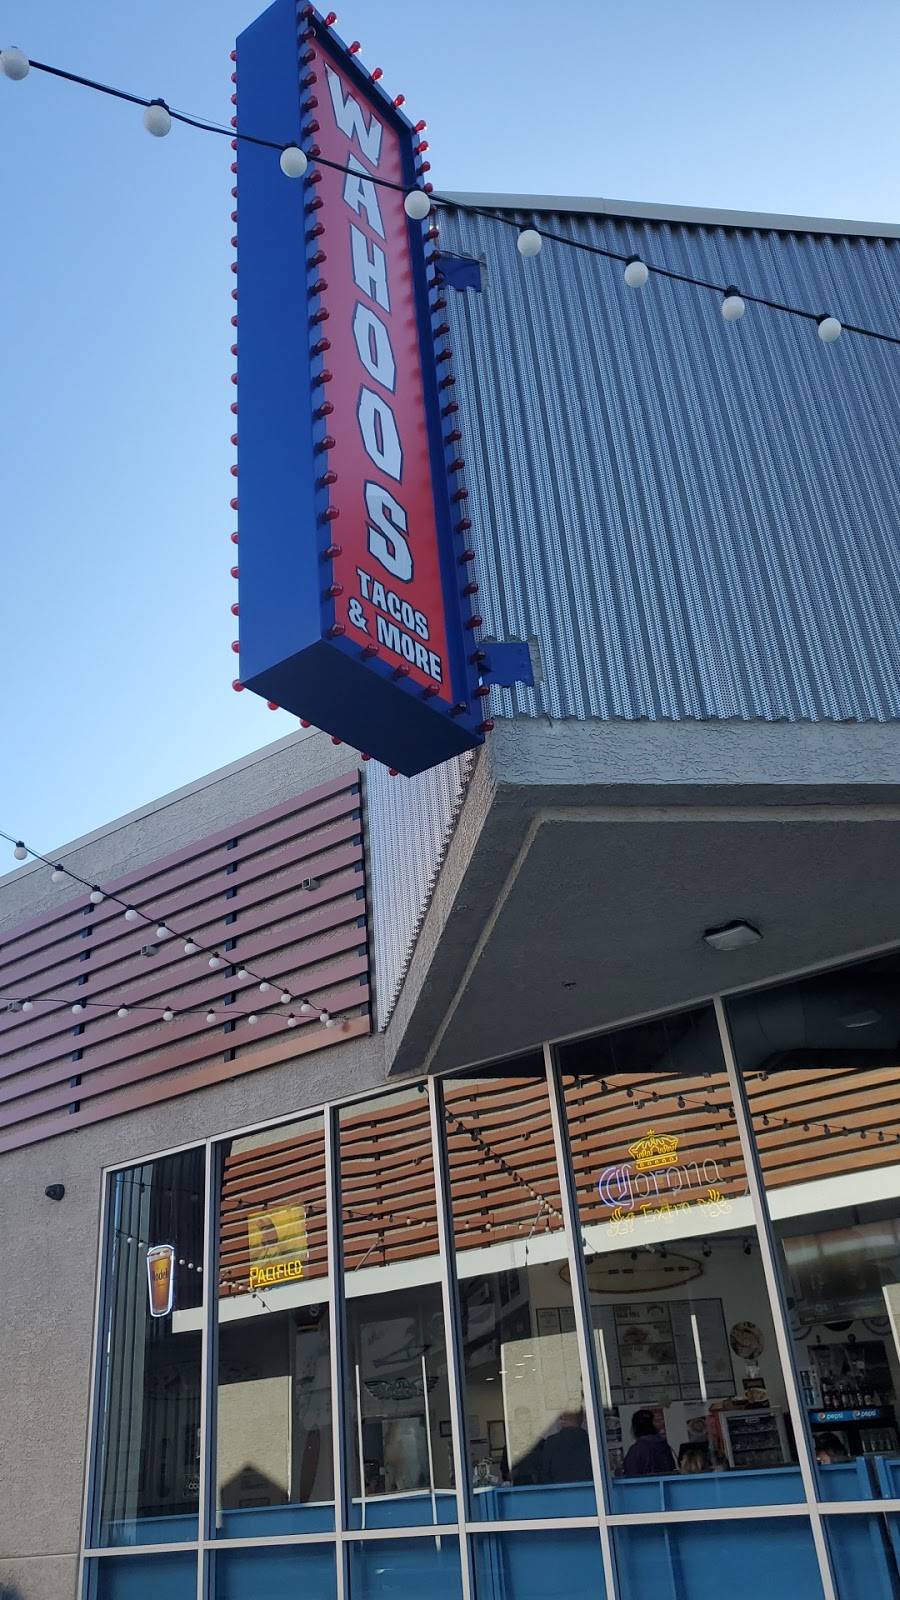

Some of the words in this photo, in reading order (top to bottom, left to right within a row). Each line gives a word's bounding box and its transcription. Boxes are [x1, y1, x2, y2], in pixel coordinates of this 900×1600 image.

[323, 61, 415, 584] WAHOOS
[348, 597, 373, 635] &
[376, 615, 444, 683] MORE
[356, 567, 430, 641] TACOS
[598, 1158, 724, 1210] Corona
[249, 1259, 303, 1289] PACIFICO
